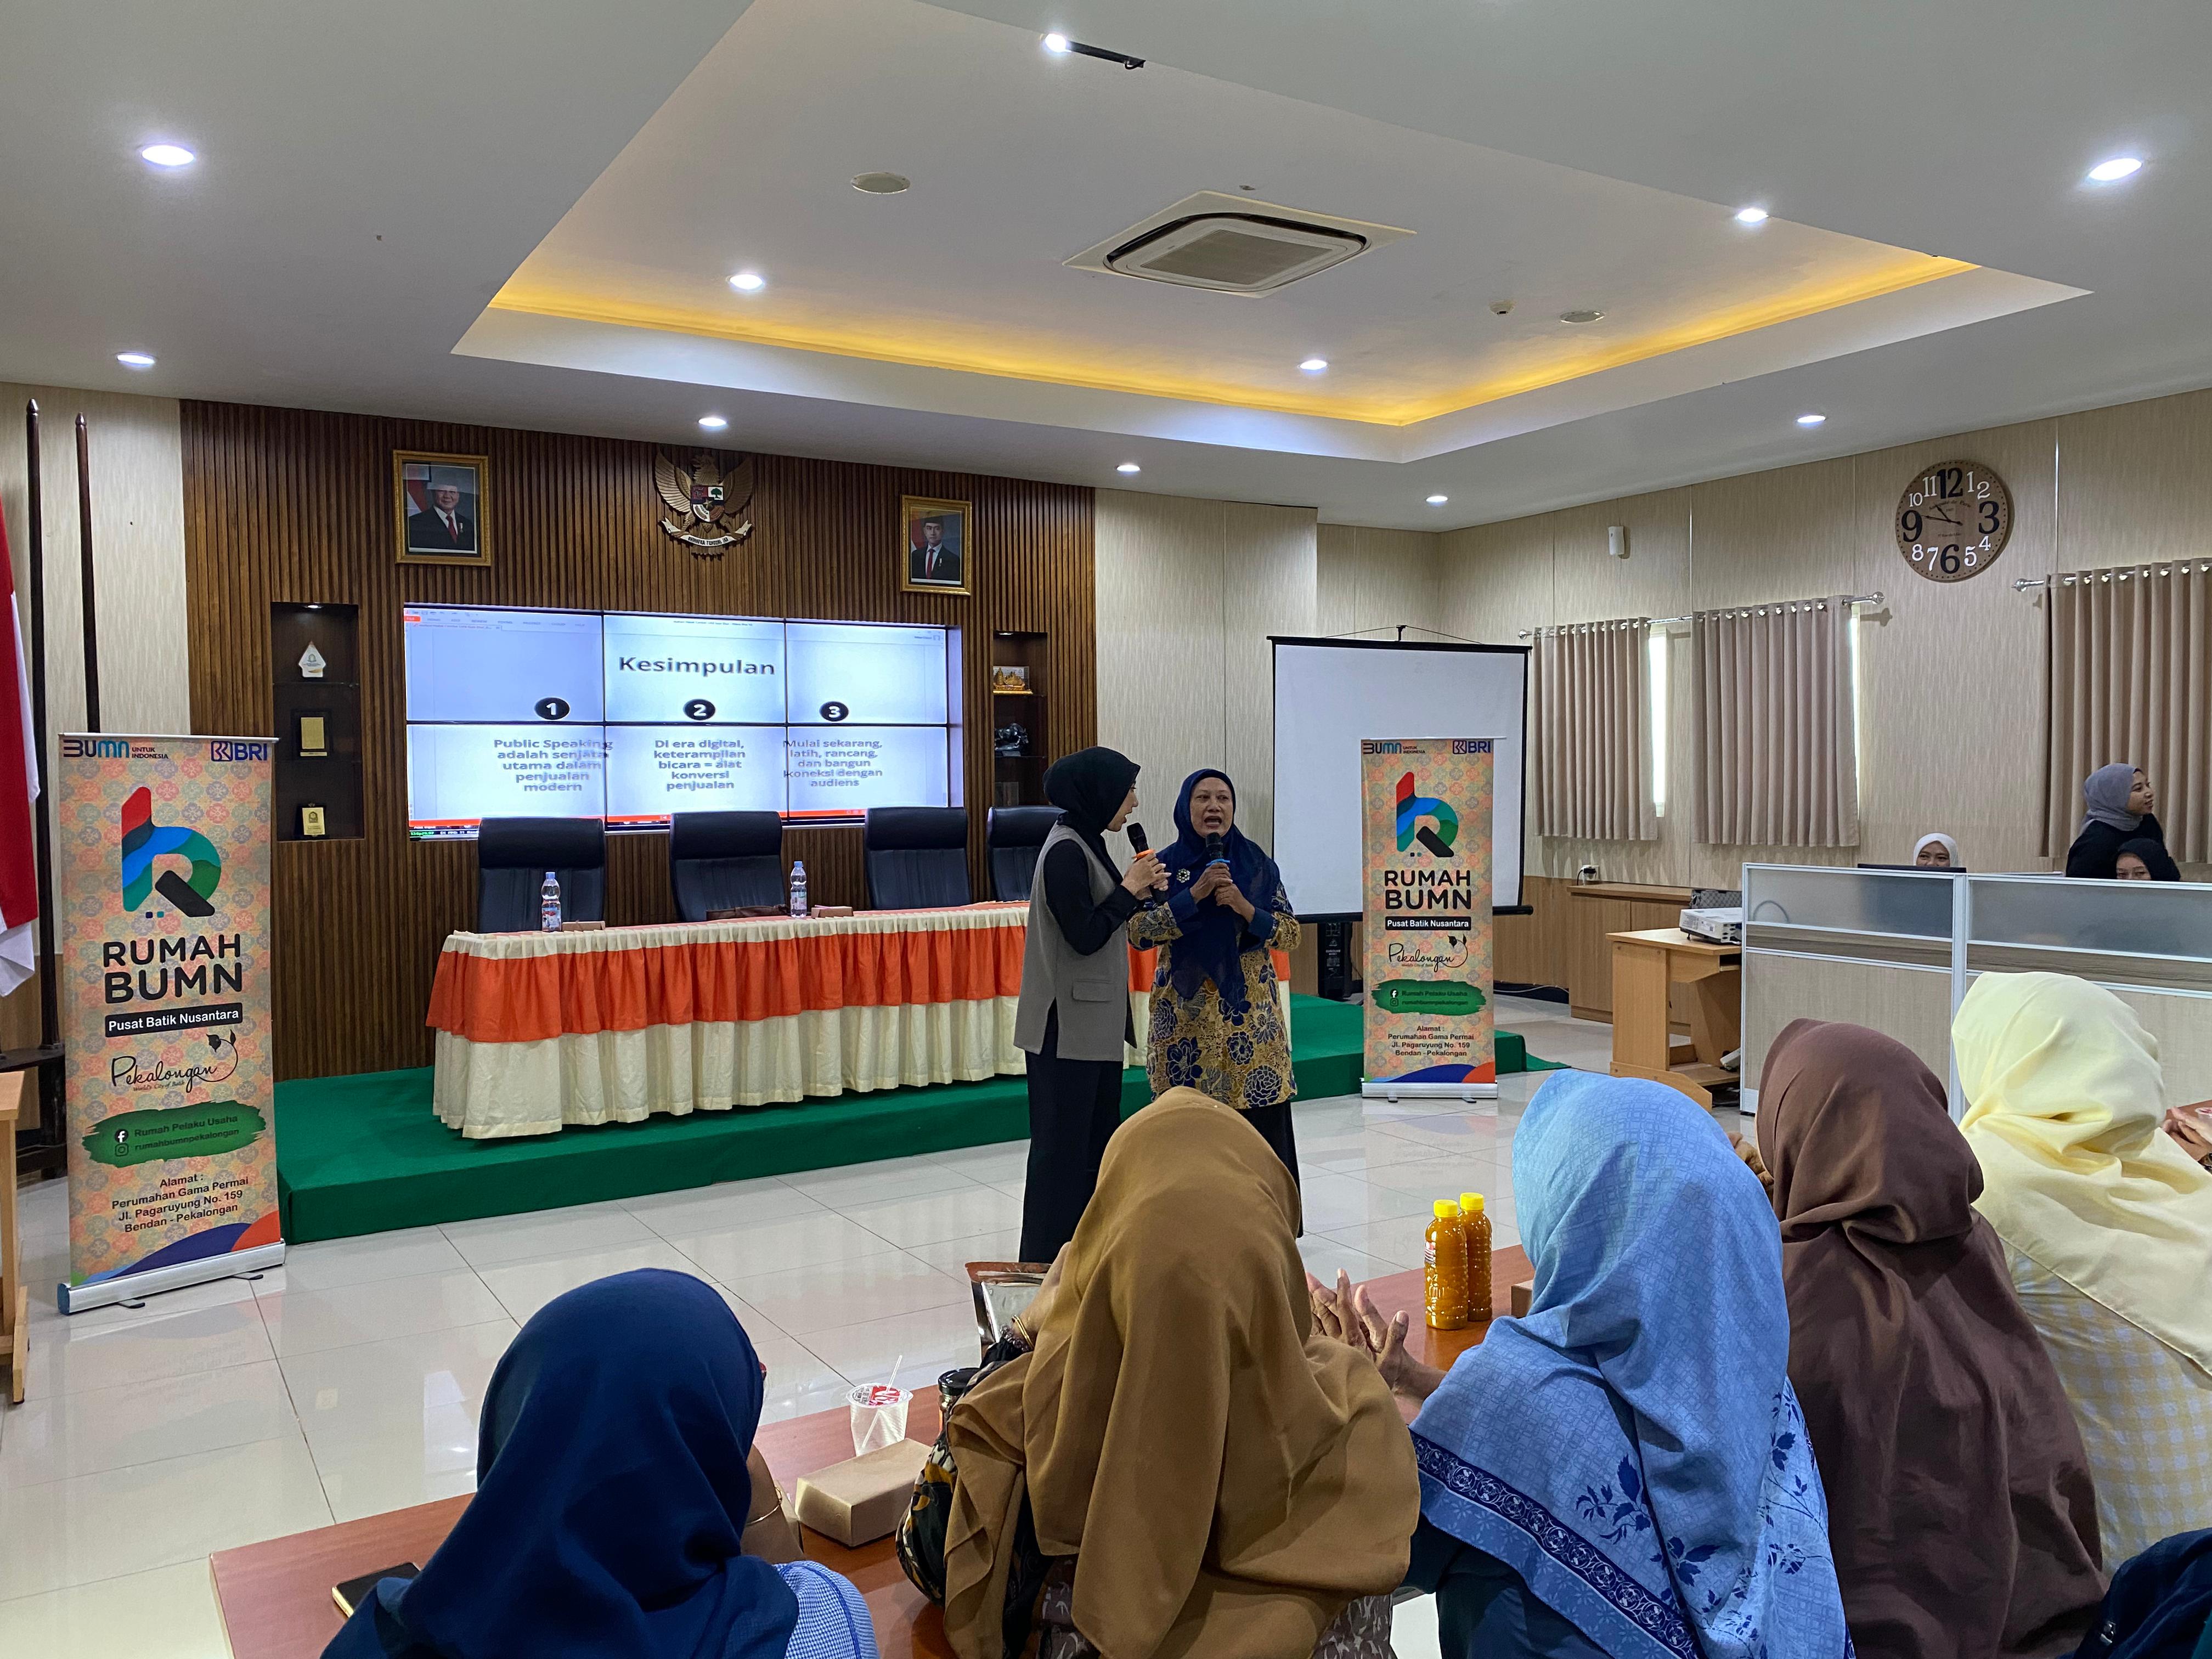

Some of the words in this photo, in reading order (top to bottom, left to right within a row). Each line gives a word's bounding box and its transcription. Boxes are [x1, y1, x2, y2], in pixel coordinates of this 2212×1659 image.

[1922, 476, 1937, 497] 11
[1937, 467, 1963, 499] 12
[1967, 471, 1974, 493] 1
[1977, 481, 1991, 500] 2
[1909, 492, 1923, 507] 10
[1978, 500, 2000, 534] 3
[1901, 510, 1923, 543] 9
[1978, 535, 1991, 551] 4
[1911, 544, 1924, 561] 8
[1927, 547, 1939, 571] 7
[1940, 544, 1960, 574] 6
[1964, 546, 1978, 567] 5
[619, 656, 775, 677] Kesimpulan
[546, 703, 557, 715] 1
[693, 704, 707, 716] 2
[828, 706, 841, 718] 3
[235, 743, 268, 761] BRI
[494, 740, 540, 748] Public
[543, 740, 613, 751] Speaking
[699, 740, 744, 750] digital,
[823, 740, 882, 749] sekarang,
[1468, 741, 1491, 753] BRI
[497, 750, 549, 759] adalah
[552, 751, 609, 761] senjata
[654, 750, 746, 760] keterampilan
[790, 749, 822, 758] latih,
[826, 750, 878, 758] rancang,
[556, 761, 601, 769] dalam
[825, 759, 871, 769] bangun
[516, 772, 590, 783] penjualan
[672, 771, 730, 779] konversi
[837, 769, 883, 778] dengan
[524, 783, 583, 792] modern
[667, 781, 735, 792] penjualan
[1384, 870, 1471, 887] RUMAH
[1385, 889, 1471, 910] BUMN
[103, 934, 240, 967] RUMAH
[1389, 943, 1454, 972] Pekalongan
[105, 962, 242, 1003] BUMN
[109, 1018, 144, 1032] Pusat
[146, 1014, 176, 1028] Batik
[180, 1009, 239, 1025] Nusantara
[1402, 1042, 1442, 1050] Pagaruyung
[111, 1056, 217, 1093] Pekalongan
[134, 1124, 169, 1137] Rumah
[172, 1121, 205, 1132] Pelaku
[207, 1115, 238, 1128] Usaha
[160, 1174, 199, 1188] Alamat
[112, 1192, 175, 1209] Perumahan
[178, 1186, 210, 1198] Gama
[212, 1177, 249, 1193] Permai
[135, 1199, 201, 1219] Pagaruyung
[204, 1193, 221, 1205] No.
[224, 1190, 243, 1201] 159
[125, 1216, 167, 1233] Bendan
[177, 1204, 238, 1223] Pekalongan
